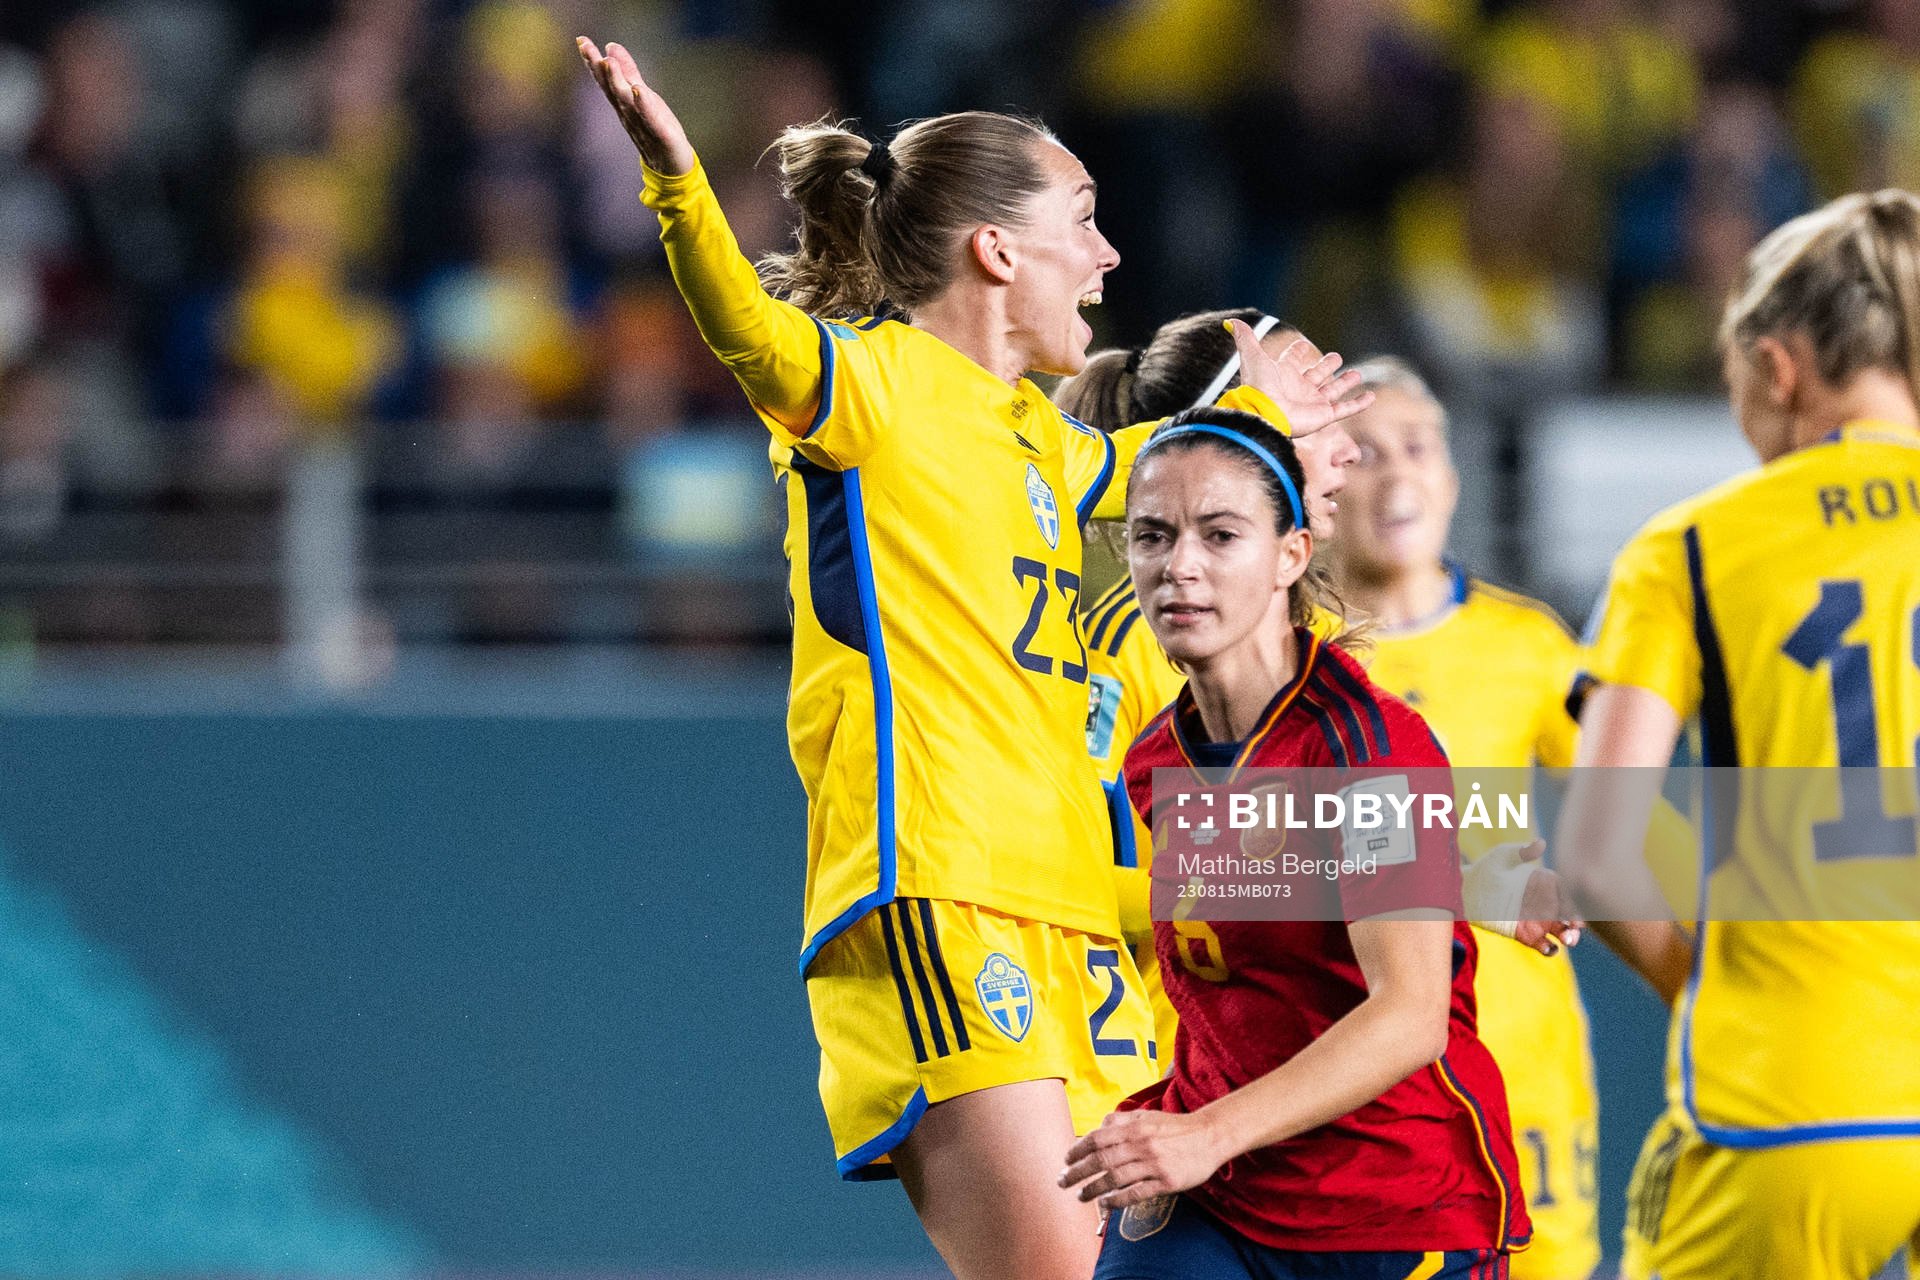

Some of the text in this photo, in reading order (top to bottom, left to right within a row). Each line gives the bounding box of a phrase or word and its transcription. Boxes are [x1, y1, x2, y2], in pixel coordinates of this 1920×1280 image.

[1780, 577, 1920, 863] 1
[1172, 876, 1230, 982] 6
[1087, 948, 1158, 1061] 2
